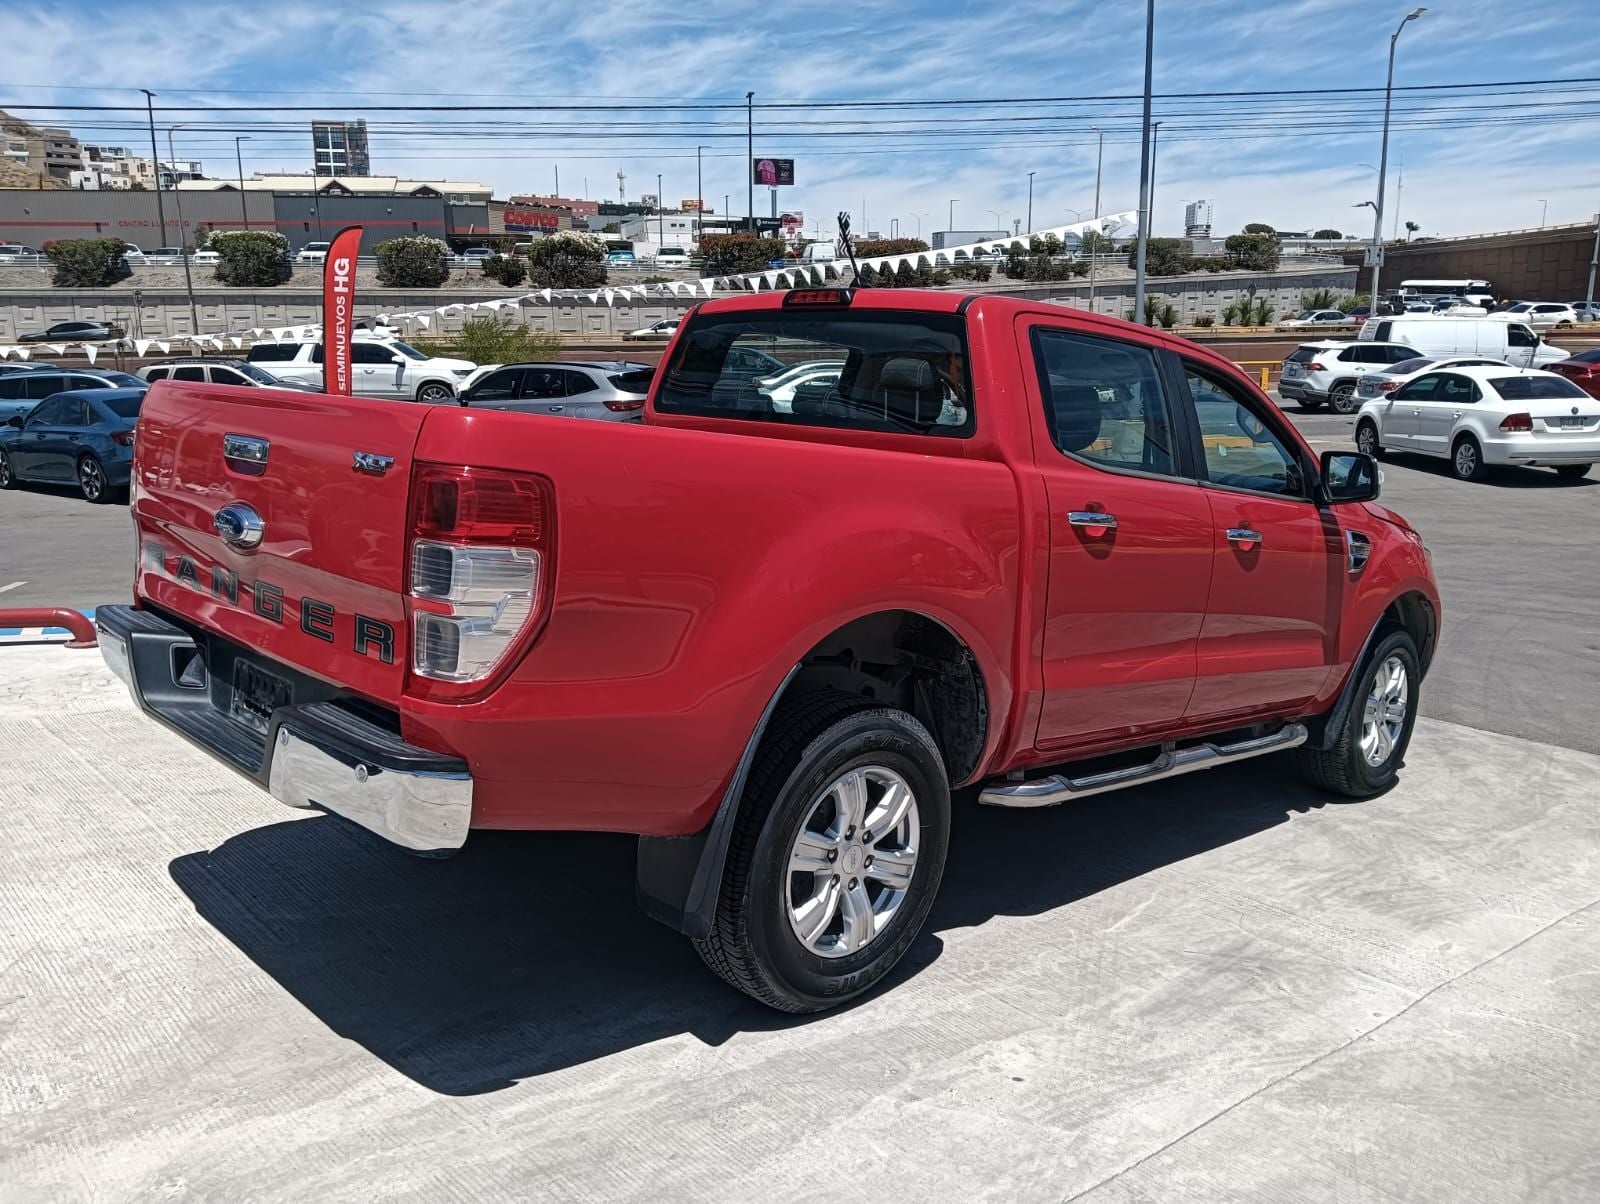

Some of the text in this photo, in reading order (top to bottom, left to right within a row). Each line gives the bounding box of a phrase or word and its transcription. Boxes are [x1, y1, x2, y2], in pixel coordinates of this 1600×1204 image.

[118, 219, 190, 227] CENTRO LLNTEO
[504, 208, 559, 228] COSTCO
[334, 258, 350, 391] SEMINUEVOS HG
[353, 451, 395, 473] XLT
[144, 540, 394, 665] RANGER
